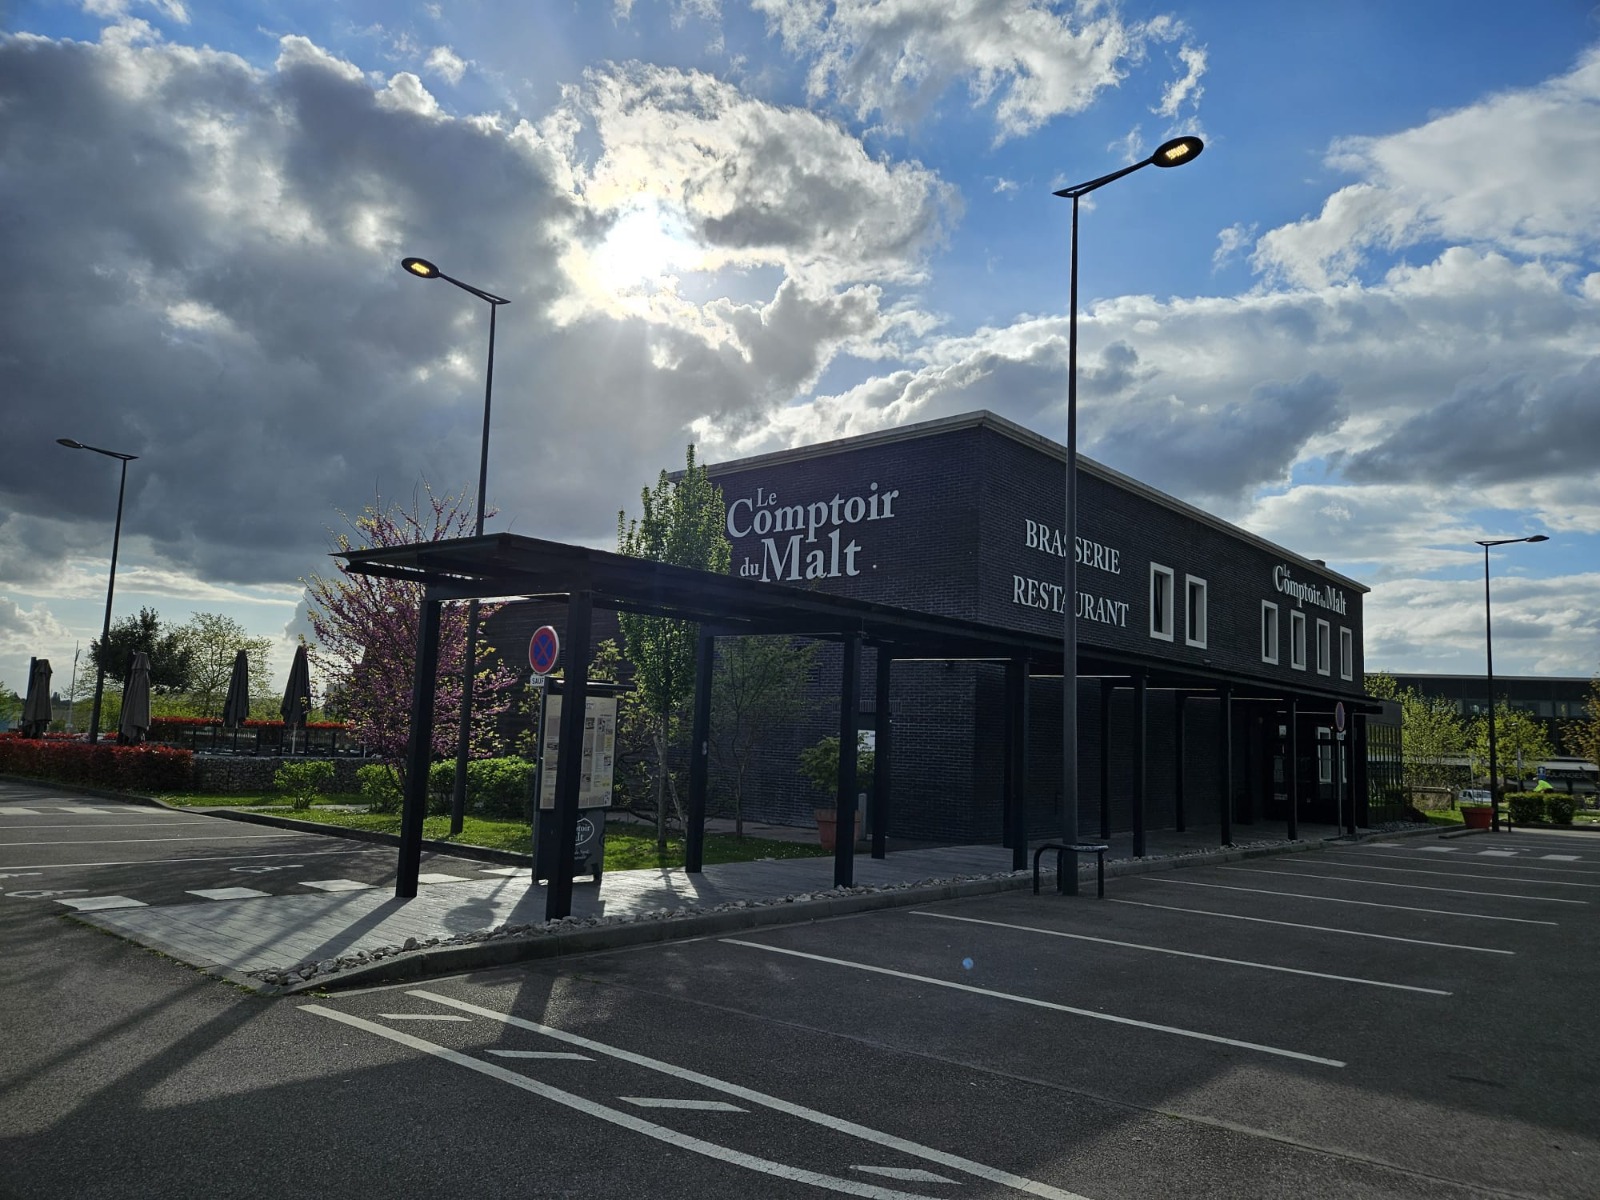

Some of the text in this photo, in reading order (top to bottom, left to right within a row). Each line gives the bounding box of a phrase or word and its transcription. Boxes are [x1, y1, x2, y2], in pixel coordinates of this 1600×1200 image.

[727, 482, 899, 543] Comptoir
[756, 488, 777, 507] Le
[740, 528, 861, 582] du Malt
[1025, 519, 1120, 575] BRASERIE
[1274, 565, 1320, 608] Comptoir
[1326, 585, 1347, 615] Malt
